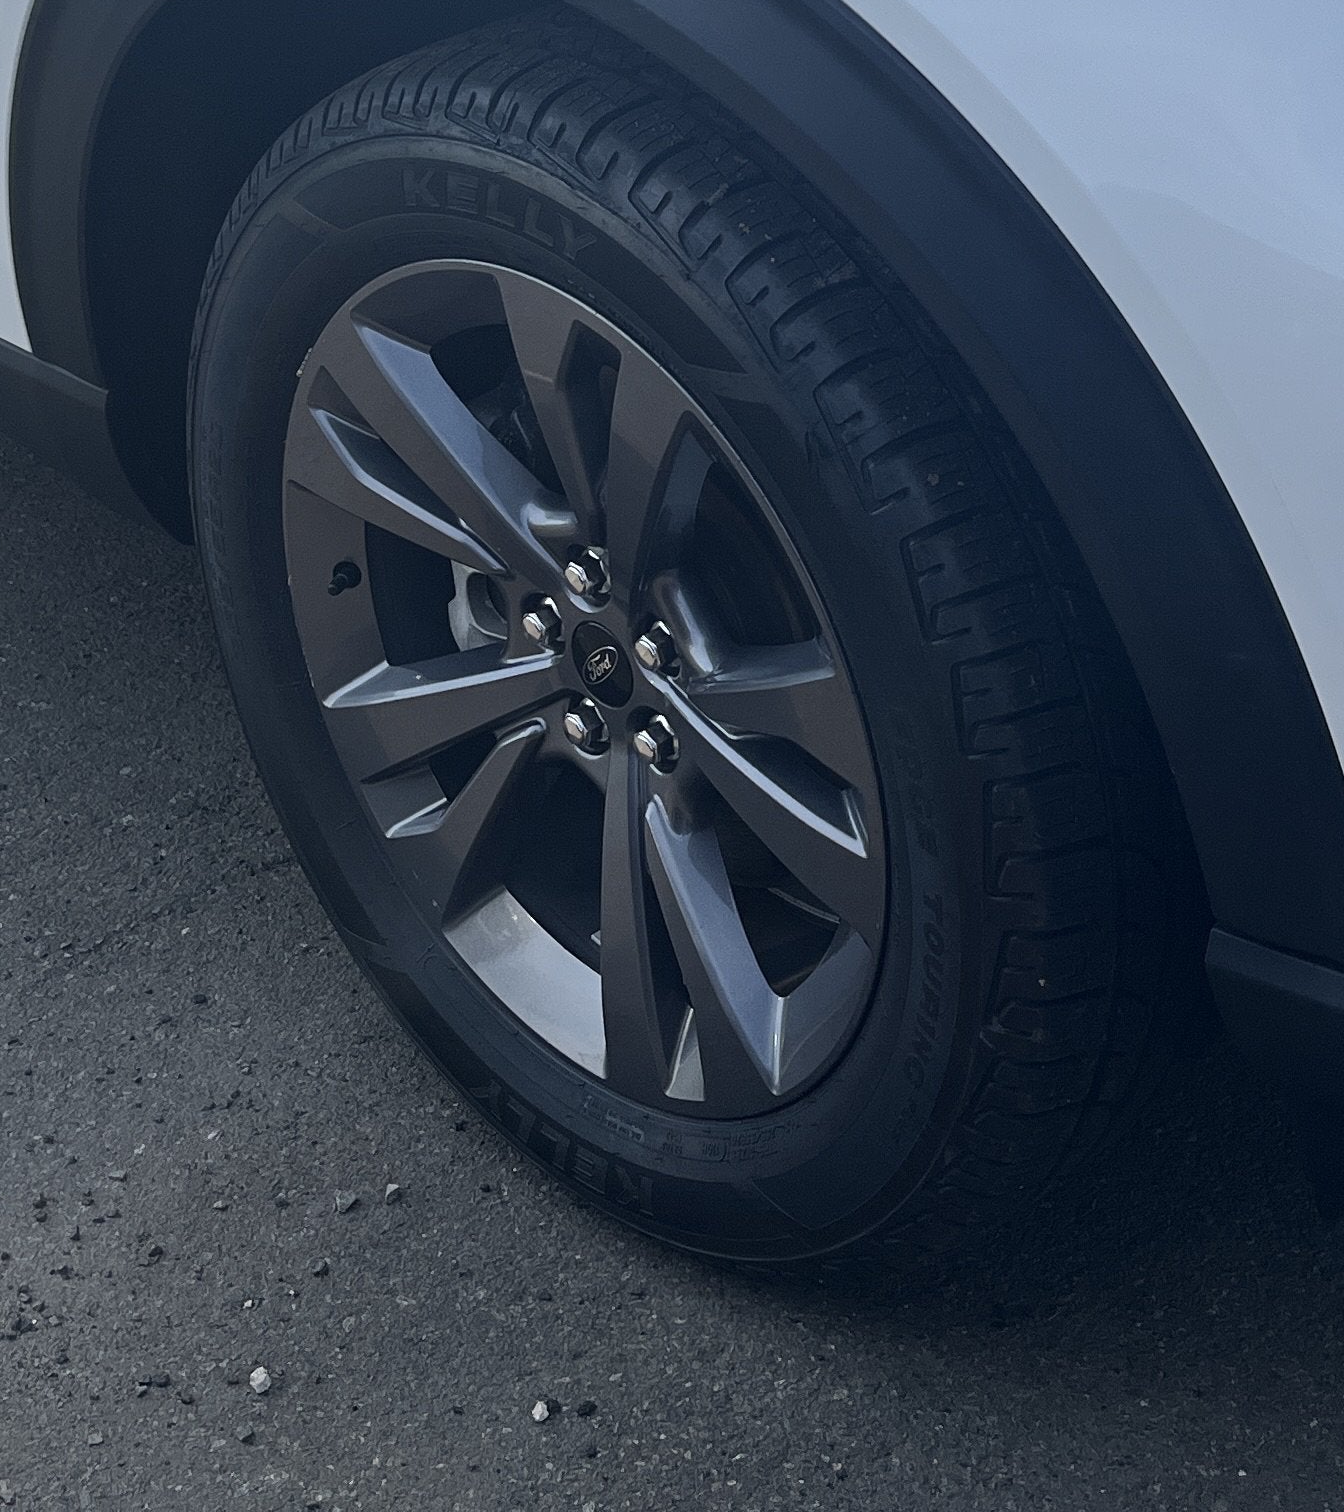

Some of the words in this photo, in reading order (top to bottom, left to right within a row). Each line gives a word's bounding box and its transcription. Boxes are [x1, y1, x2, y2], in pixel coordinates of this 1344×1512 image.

[400, 166, 599, 260] KELLY
[586, 653, 612, 682] Ford
[903, 893, 945, 1089] TOURING
[467, 1078, 654, 1217] KELLY
